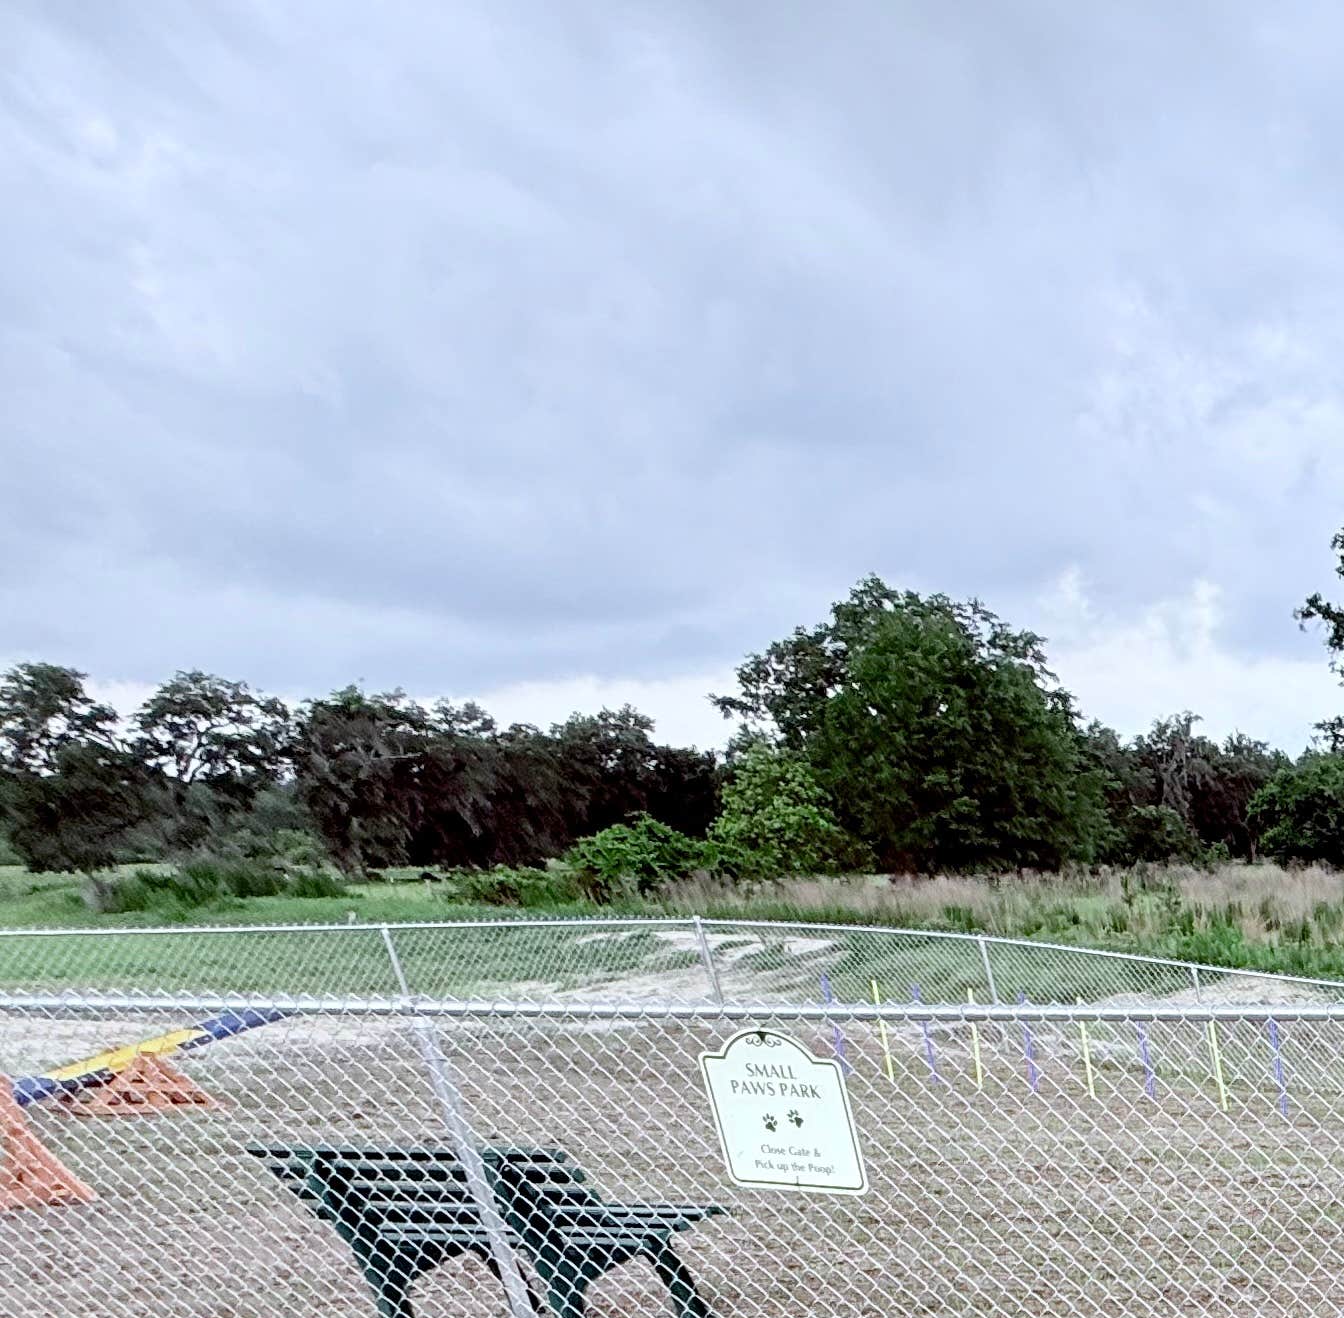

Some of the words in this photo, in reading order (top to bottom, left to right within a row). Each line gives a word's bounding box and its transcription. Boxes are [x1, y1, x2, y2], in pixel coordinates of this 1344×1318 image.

[745, 1062, 798, 1080] SMALL
[730, 1079, 776, 1097] PAWS
[779, 1082, 822, 1100] PARK
[760, 1143, 786, 1155] Close
[788, 1146, 811, 1158] Gate
[754, 1159, 775, 1170] Pick
[777, 1163, 788, 1174] up
[791, 1162, 805, 1172] the
[808, 1163, 835, 1176] Poop!
